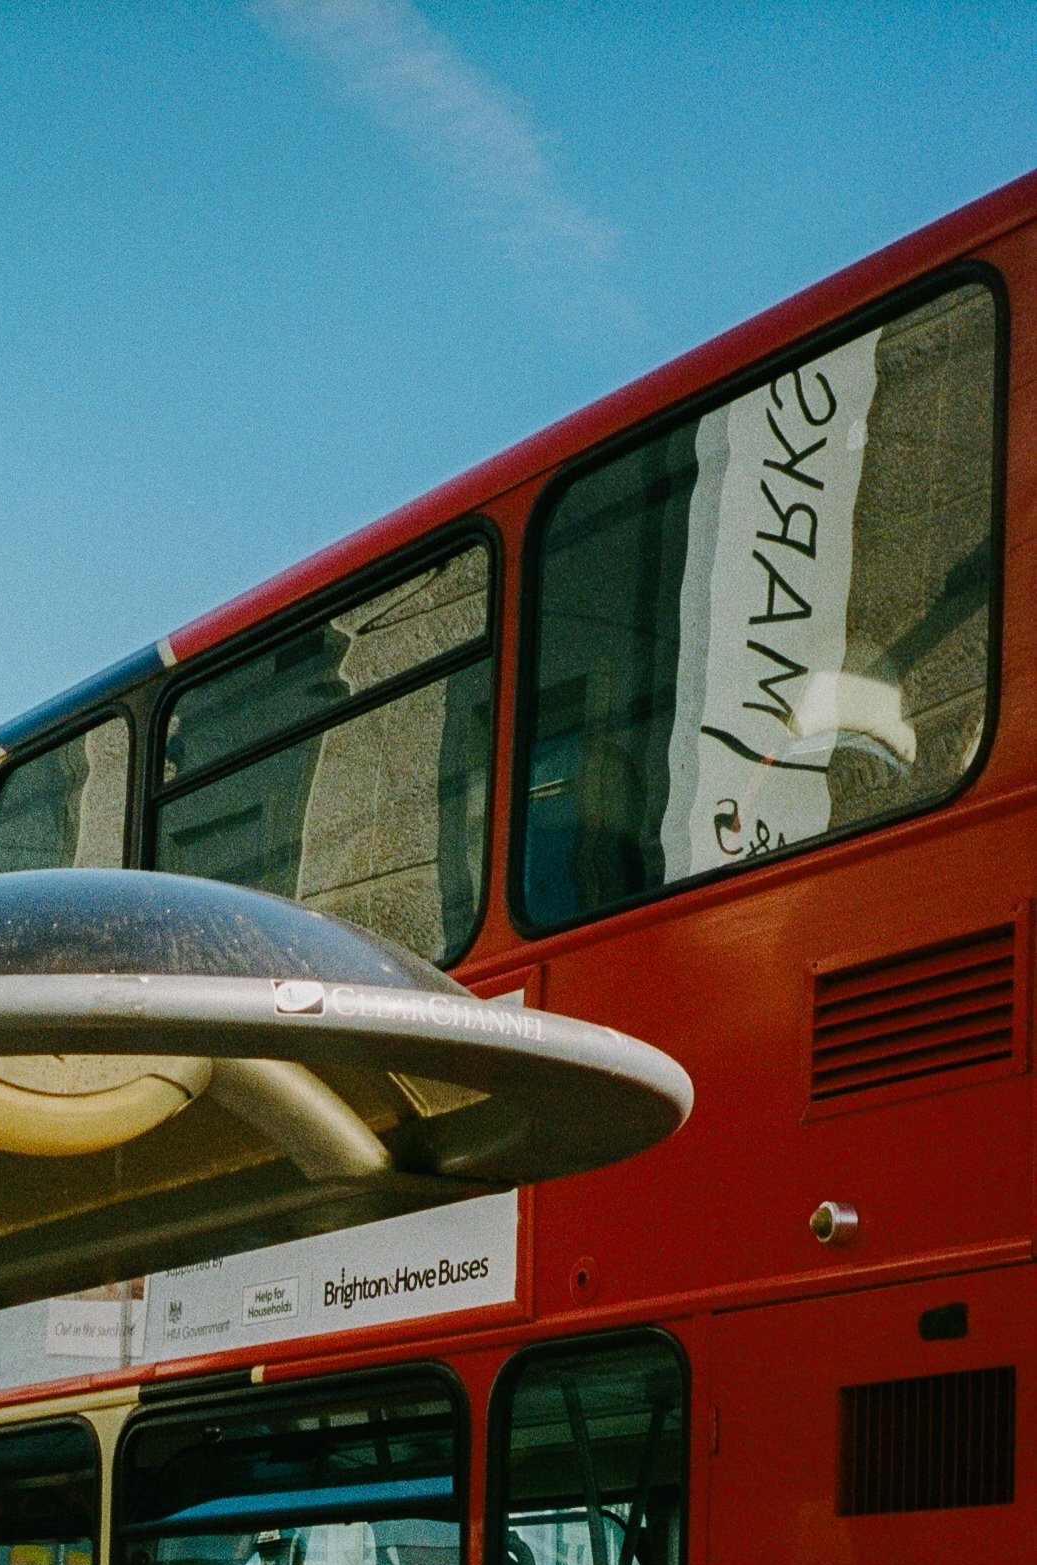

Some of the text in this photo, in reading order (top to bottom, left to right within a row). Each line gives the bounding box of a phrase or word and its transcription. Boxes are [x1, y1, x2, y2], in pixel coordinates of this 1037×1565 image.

[438, 1257, 489, 1286] Buses
[255, 1287, 286, 1305] Help for
[247, 1300, 293, 1319] Households
[182, 1319, 231, 1339] Government
